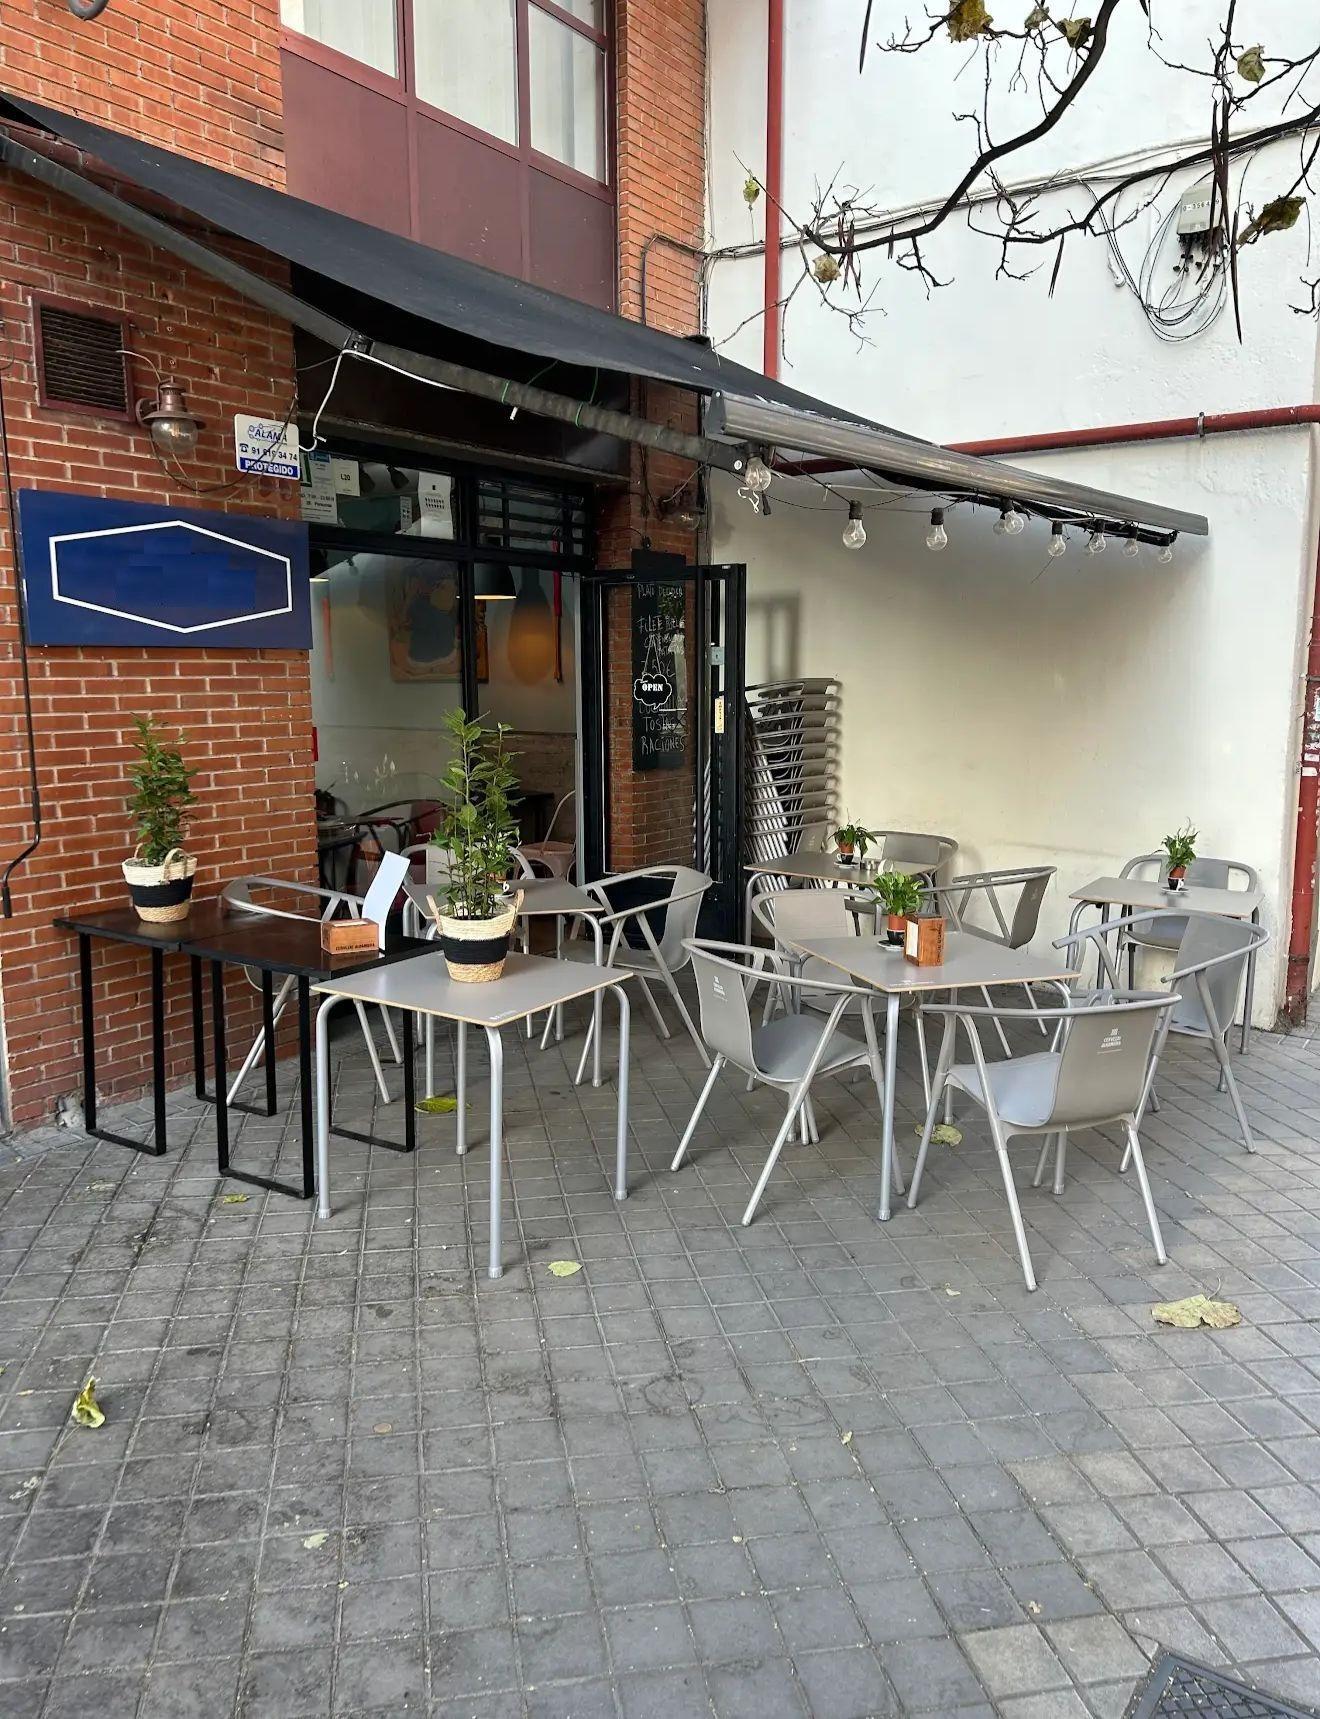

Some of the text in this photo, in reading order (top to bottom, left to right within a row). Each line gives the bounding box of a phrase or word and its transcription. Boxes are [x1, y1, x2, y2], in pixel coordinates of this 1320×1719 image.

[251, 446, 261, 455] 91
[278, 451, 288, 460] 34
[289, 452, 298, 461] 74
[244, 459, 294, 476] PROTEGIDO
[641, 683, 664, 692] OPEN
[640, 734, 689, 757] RACIONES
